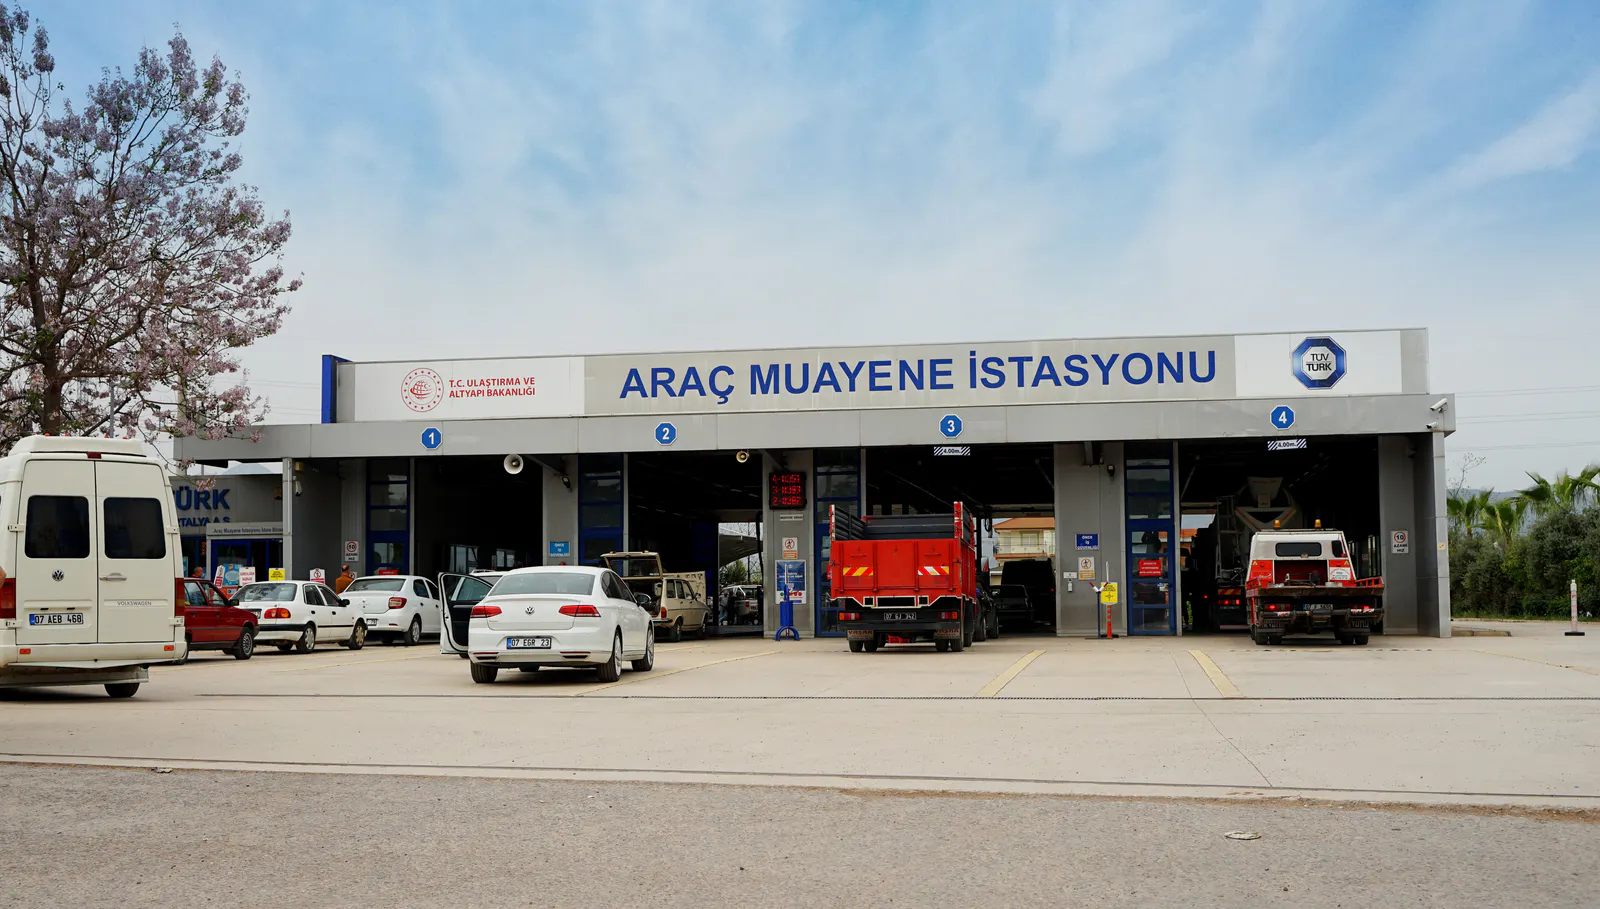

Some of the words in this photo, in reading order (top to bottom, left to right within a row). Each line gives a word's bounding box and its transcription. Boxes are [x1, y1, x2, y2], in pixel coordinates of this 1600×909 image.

[449, 380, 465, 388] T.C.
[466, 378, 520, 389] ULAŞTIRMA
[524, 377, 535, 385] VE
[619, 365, 735, 405] ARAÇ
[749, 358, 954, 396] MUAYENE
[968, 350, 1216, 390] İSTASYONU
[449, 390, 484, 398] ALTYAPI
[486, 387, 536, 397] BAKANLIĞI
[1278, 410, 1288, 424] 4
[948, 420, 955, 432] 3
[428, 432, 434, 444] 1
[662, 428, 670, 440] 2
[173, 486, 230, 511] ÜRK
[178, 516, 212, 527] TALYA
[48, 616, 62, 624] AEB
[67, 615, 82, 623] 468
